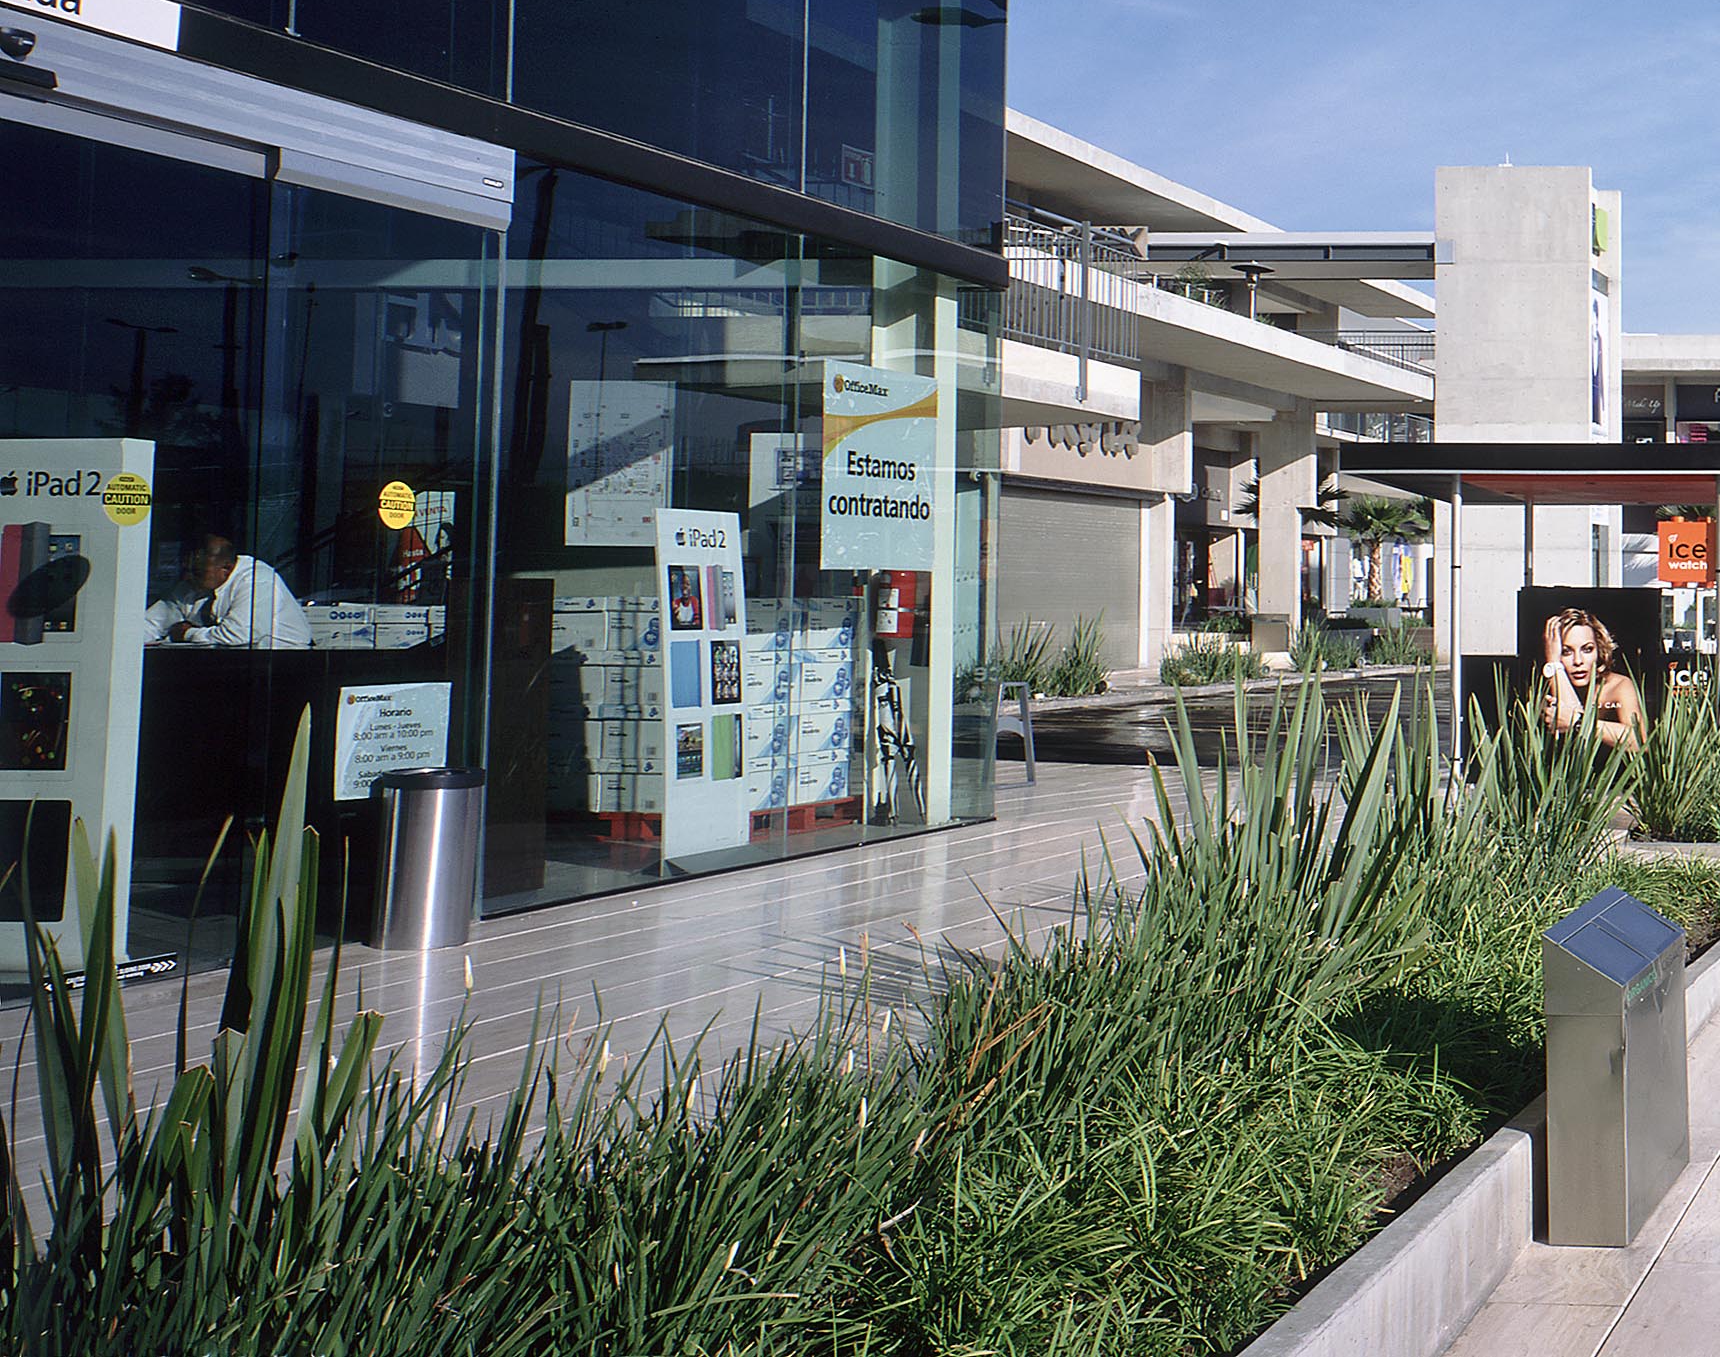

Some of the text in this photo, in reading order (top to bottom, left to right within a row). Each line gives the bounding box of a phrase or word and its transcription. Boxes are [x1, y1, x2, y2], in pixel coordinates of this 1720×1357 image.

[844, 379, 888, 397] OfficeMax
[847, 450, 916, 481] Estamos
[27, 470, 101, 496] iPad 2
[106, 484, 147, 492] AUTOMATIC
[104, 494, 149, 505] CAUTION
[380, 500, 413, 510] CAUTION
[116, 507, 136, 515] DOOR
[828, 493, 930, 521] contratando
[689, 528, 727, 549] iPad 2
[1669, 542, 1708, 559] ice
[1668, 560, 1708, 570] watch
[379, 707, 413, 718] Horario
[397, 730, 418, 739] 10:00
[380, 744, 408, 752] Viernes
